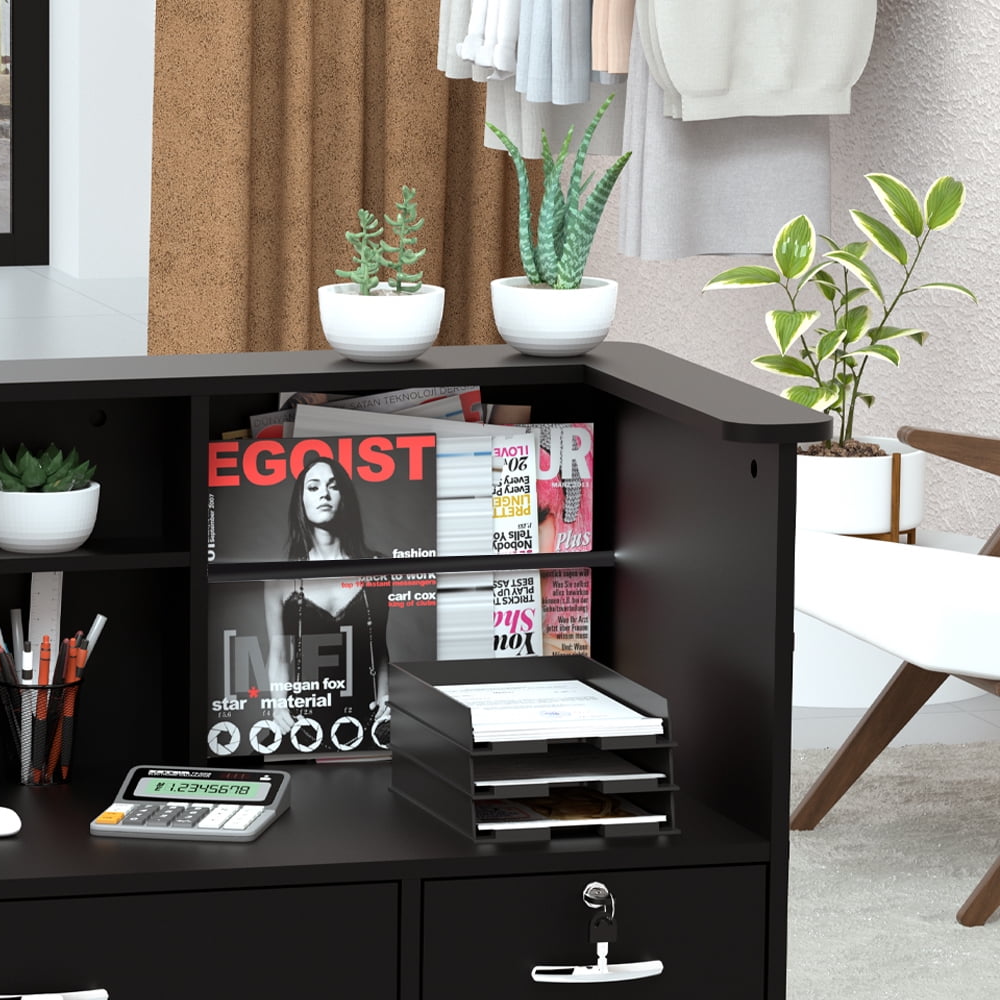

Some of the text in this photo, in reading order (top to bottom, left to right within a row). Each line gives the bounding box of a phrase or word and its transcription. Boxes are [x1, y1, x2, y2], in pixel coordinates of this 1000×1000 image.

[494, 446, 525, 457] LOVE
[208, 435, 436, 487] EGOIST
[508, 456, 529, 472] 20
[503, 475, 530, 485] Every
[504, 485, 531, 494] Every
[493, 530, 532, 541] Tells Yo
[493, 540, 533, 552] Nobody
[392, 547, 436, 558] fashion
[511, 577, 534, 587] BEST
[387, 591, 436, 601] carl cox
[497, 588, 510, 597] UP
[512, 586, 534, 596] PLAY
[503, 594, 535, 605] TRICKS
[493, 632, 535, 656] You
[270, 677, 346, 694] megan fox
[212, 692, 332, 711] star material
